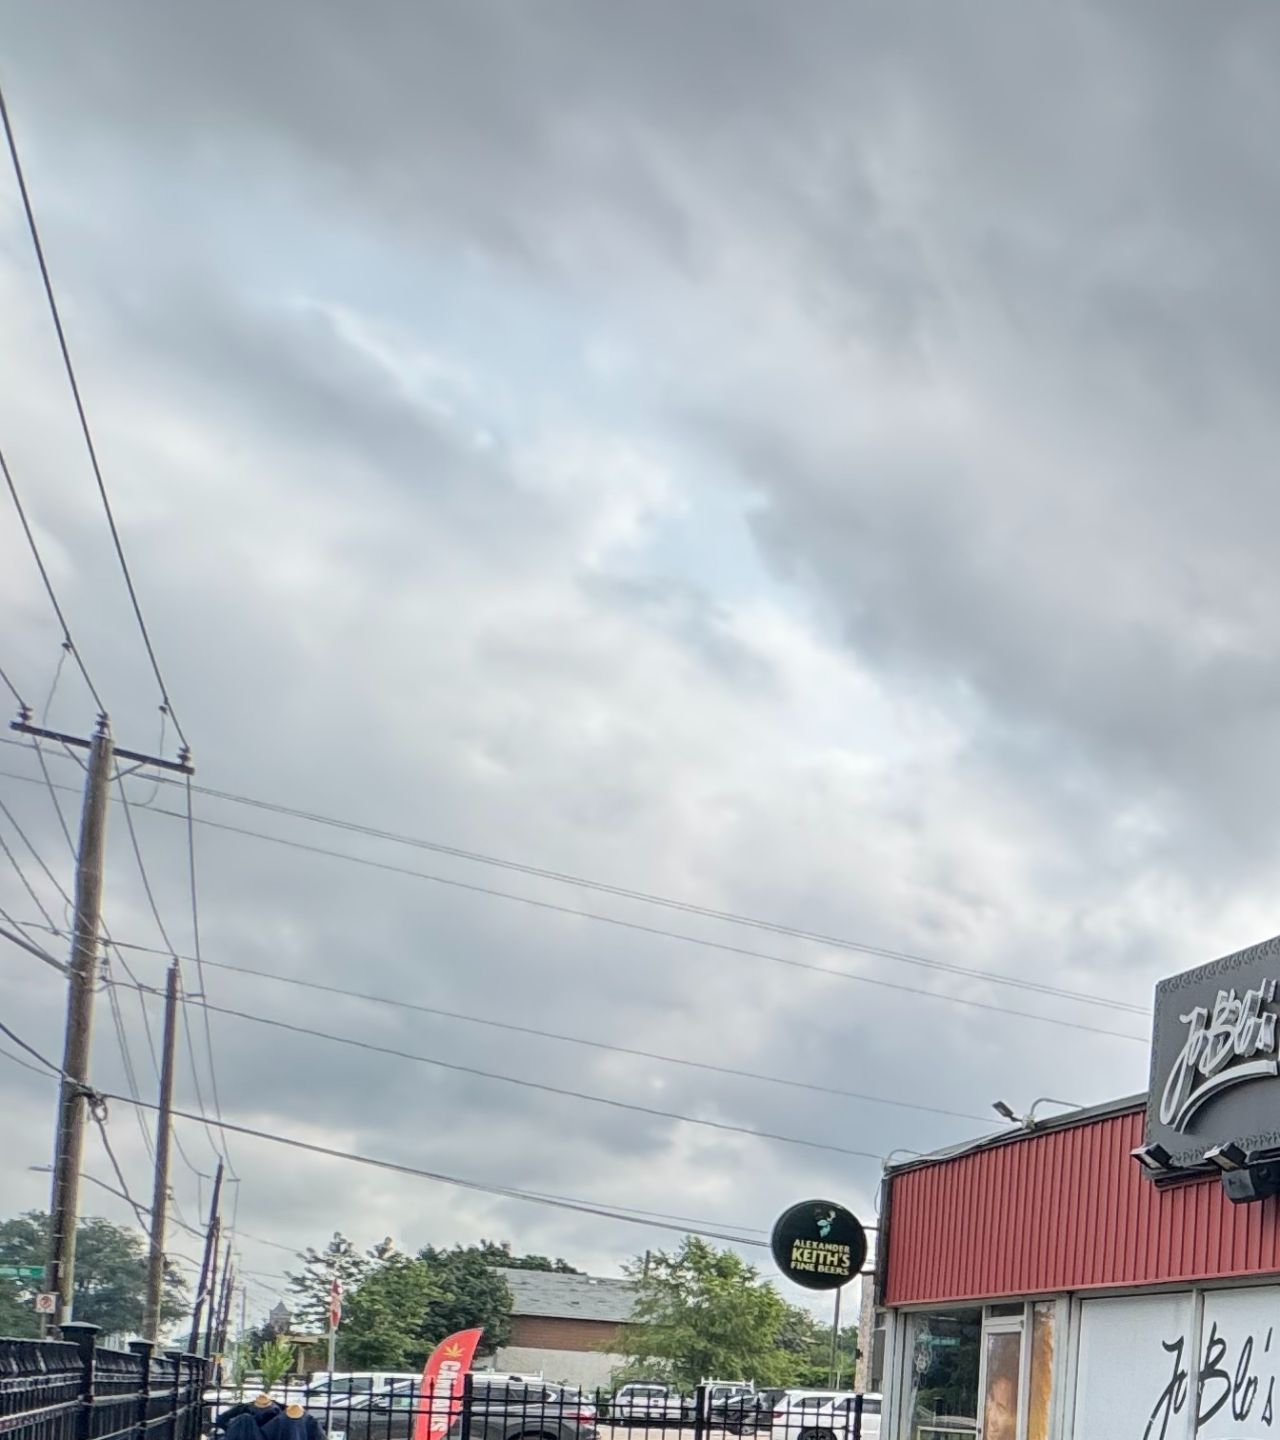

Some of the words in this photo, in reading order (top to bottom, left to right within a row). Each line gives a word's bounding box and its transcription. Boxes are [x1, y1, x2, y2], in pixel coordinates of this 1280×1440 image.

[793, 1239, 850, 1253] ALEXANDER
[791, 1247, 850, 1267] KEITH'S
[791, 1261, 815, 1271] FINE
[817, 1265, 849, 1275] BEERS
